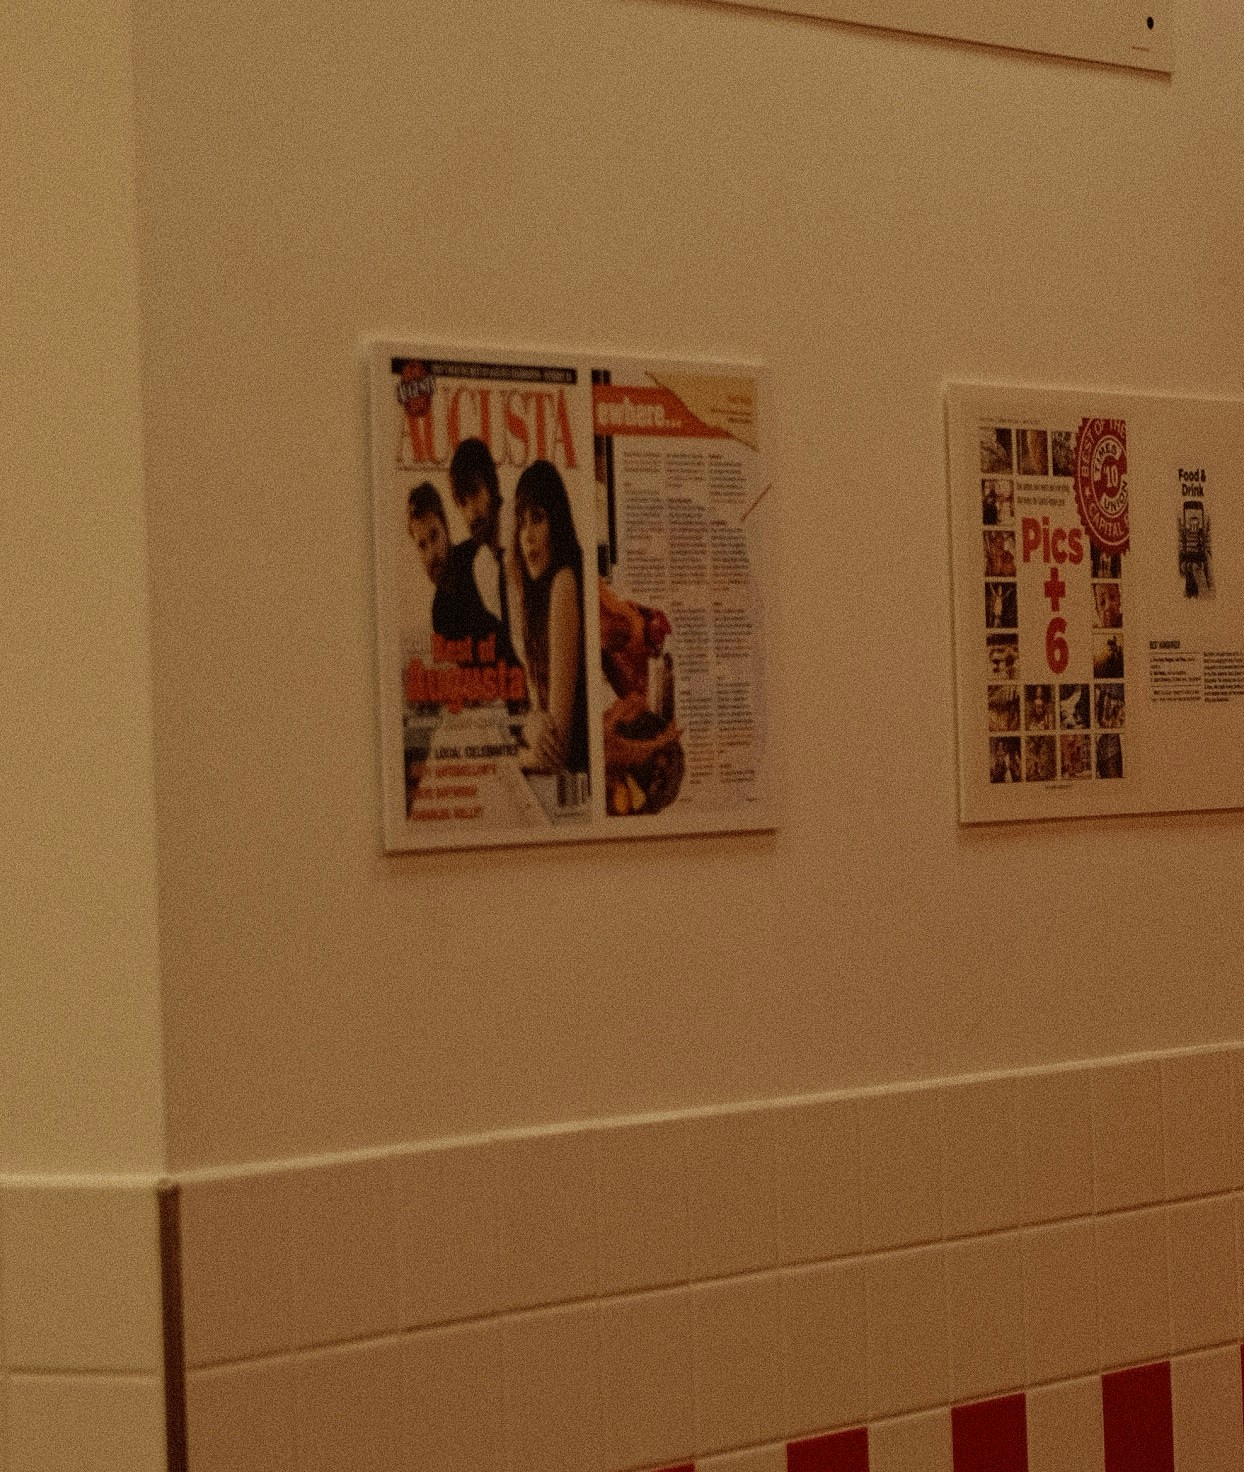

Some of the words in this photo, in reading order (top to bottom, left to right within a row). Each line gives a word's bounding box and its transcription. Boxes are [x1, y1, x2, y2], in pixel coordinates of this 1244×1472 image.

[1081, 431, 1097, 477] BEST
[1178, 468, 1199, 483] Food
[1181, 483, 1204, 497] Drink
[1022, 515, 1084, 565] Pics
[1044, 567, 1067, 612] +
[1045, 617, 1070, 675] 6
